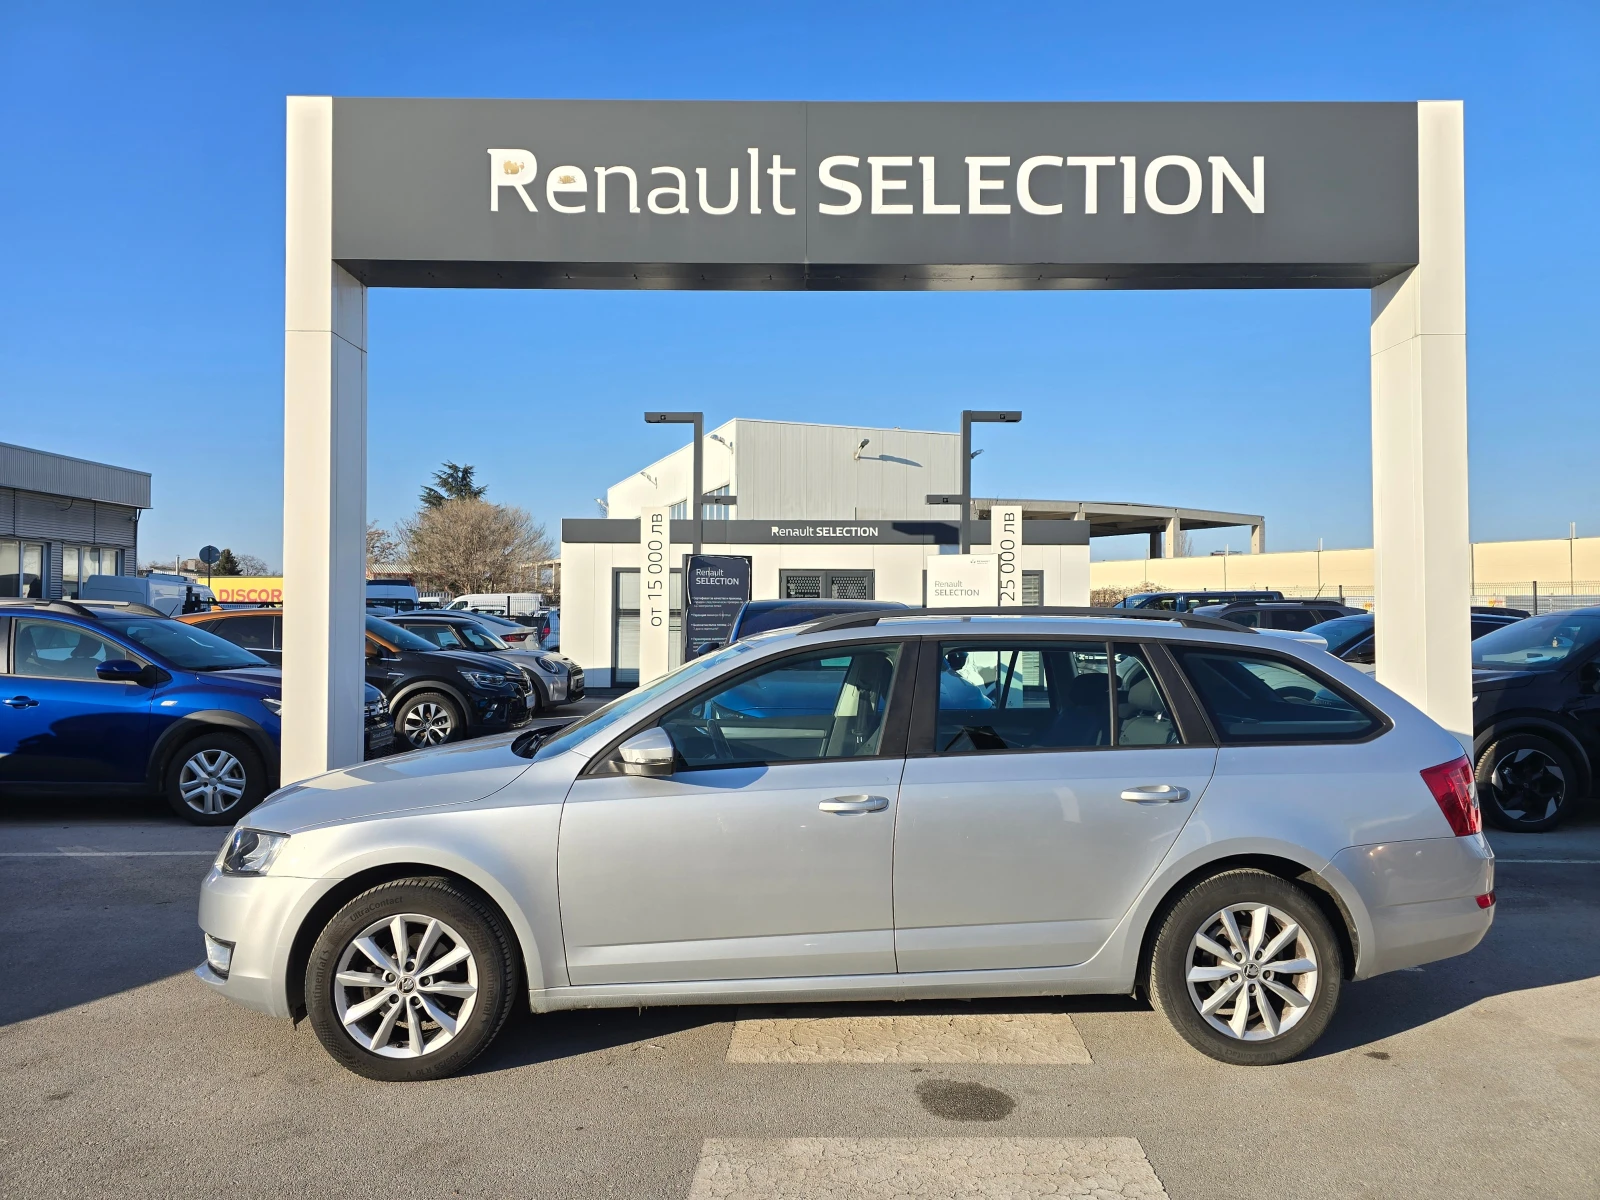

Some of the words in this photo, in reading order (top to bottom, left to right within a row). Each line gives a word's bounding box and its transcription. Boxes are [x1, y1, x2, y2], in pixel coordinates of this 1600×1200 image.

[486, 147, 796, 216] Renault
[818, 154, 1266, 216] SELECTION
[771, 526, 814, 537] Renault
[816, 526, 879, 537] SELECTION
[647, 540, 663, 574] 000
[1000, 539, 1015, 574] 000
[695, 568, 724, 577] Renault
[695, 577, 740, 586] SELECTION
[647, 580, 663, 600] 15
[934, 580, 963, 588] Renault
[934, 589, 980, 597] SELECTION
[1000, 579, 1015, 601] 25
[349, 895, 404, 923] UltraContact
